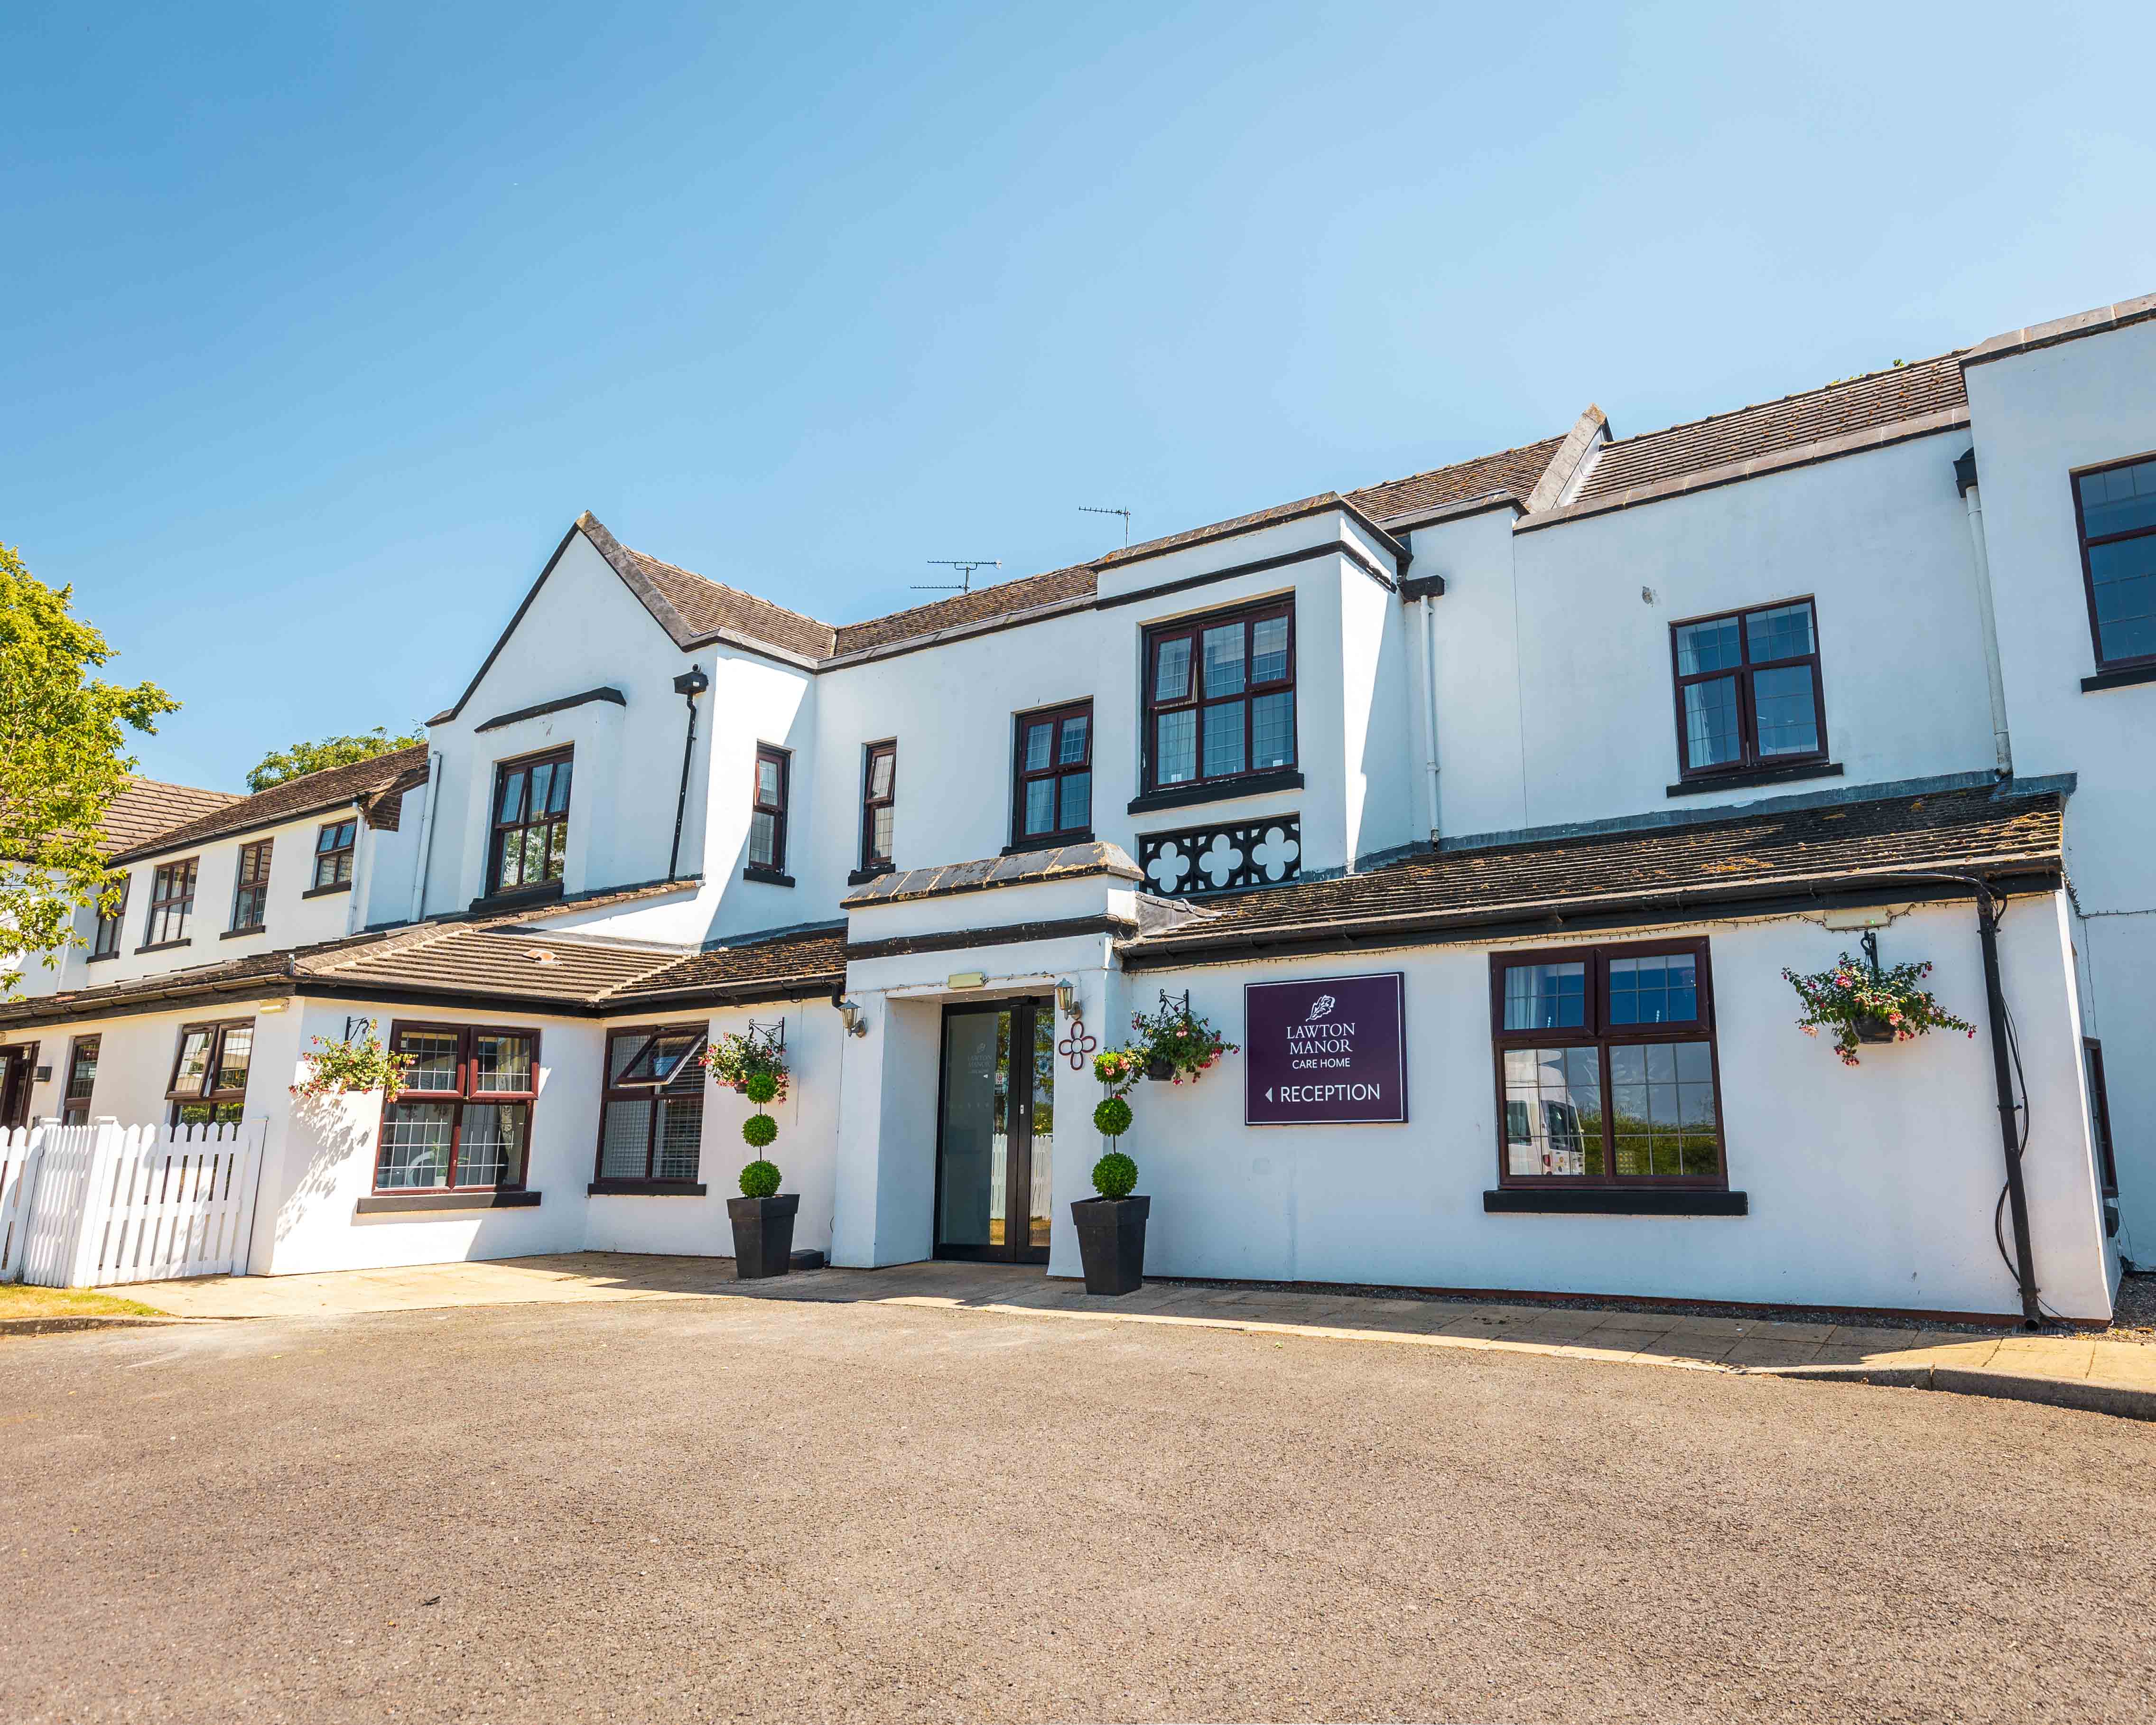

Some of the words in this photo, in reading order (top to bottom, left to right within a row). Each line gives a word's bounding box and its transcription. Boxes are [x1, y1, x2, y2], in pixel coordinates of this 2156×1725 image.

[1286, 1023, 1356, 1039] LAWTON
[1290, 1039, 1353, 1055] MANOR
[1292, 1059, 1318, 1069] CARE
[1320, 1057, 1350, 1068] HOME
[1281, 1083, 1380, 1102] RECEPTION
